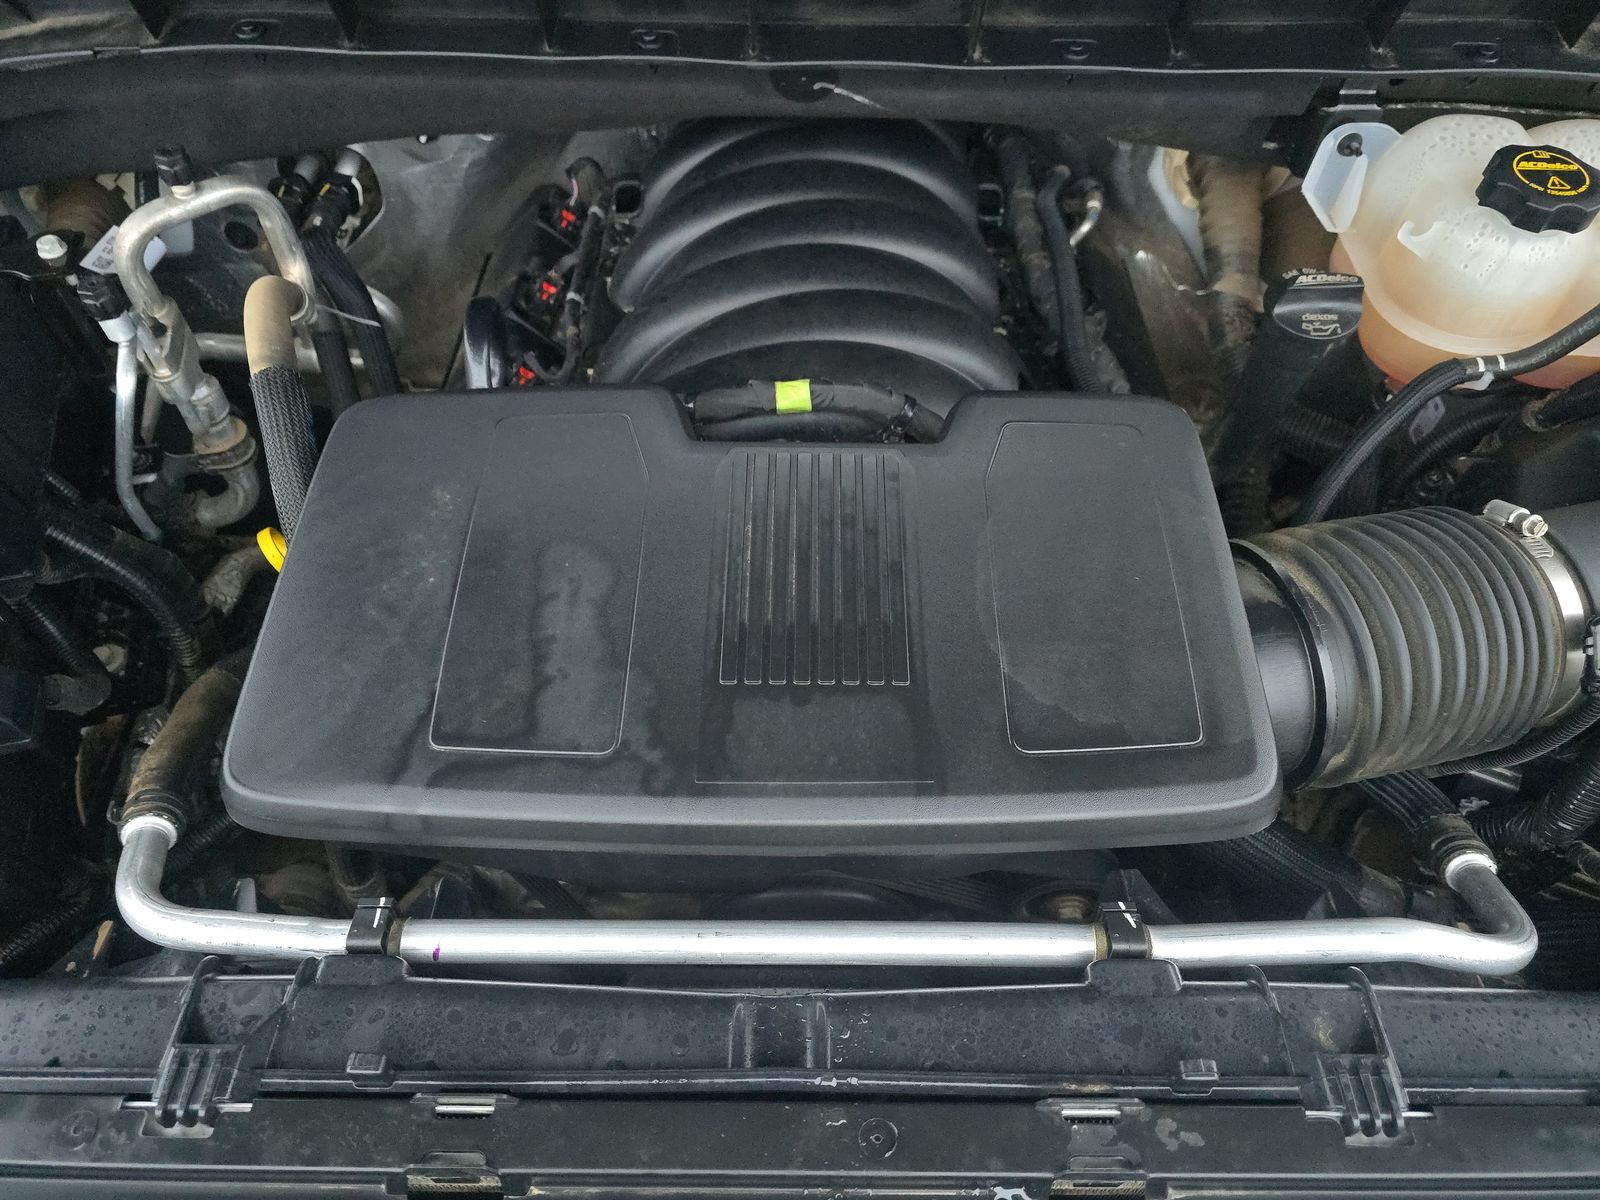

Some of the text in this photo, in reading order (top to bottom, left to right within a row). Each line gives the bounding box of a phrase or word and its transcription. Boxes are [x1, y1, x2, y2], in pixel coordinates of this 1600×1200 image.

[1517, 161, 1579, 170] ACDelco
[1295, 274, 1359, 283] ACDelco
[1302, 313, 1338, 321] dexos
